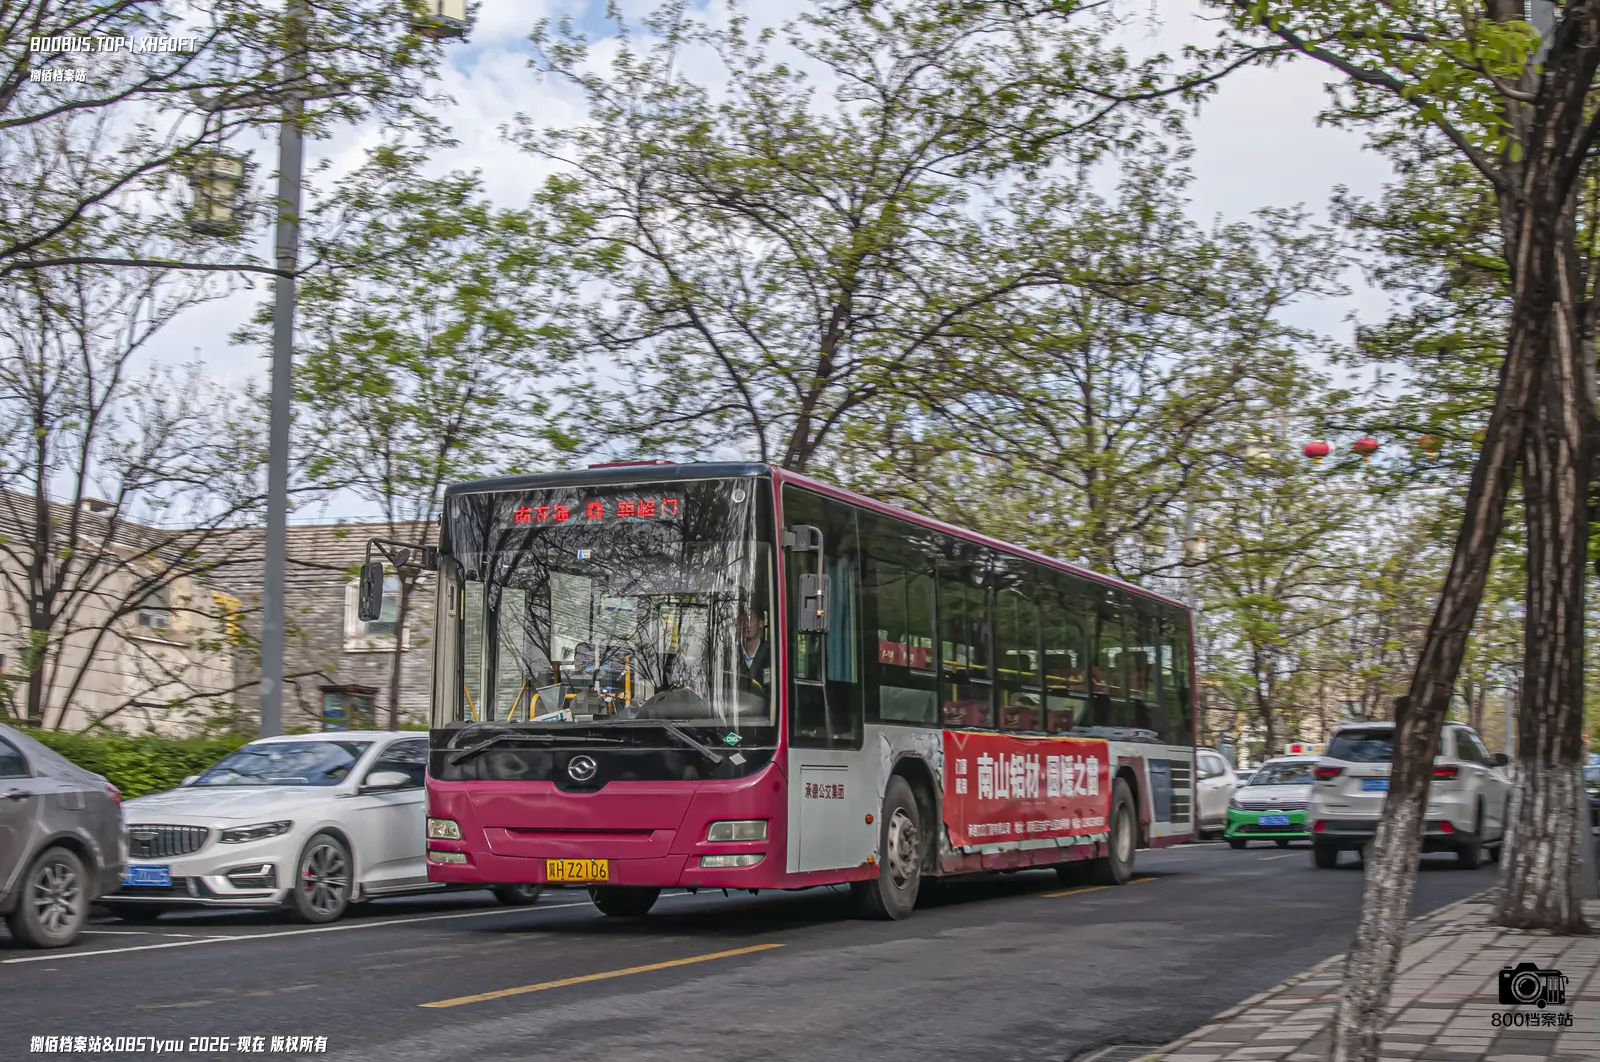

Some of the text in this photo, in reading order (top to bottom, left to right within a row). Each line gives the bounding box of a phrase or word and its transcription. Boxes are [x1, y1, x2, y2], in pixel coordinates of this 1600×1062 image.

[805, 782, 844, 799] 承德公交集团
